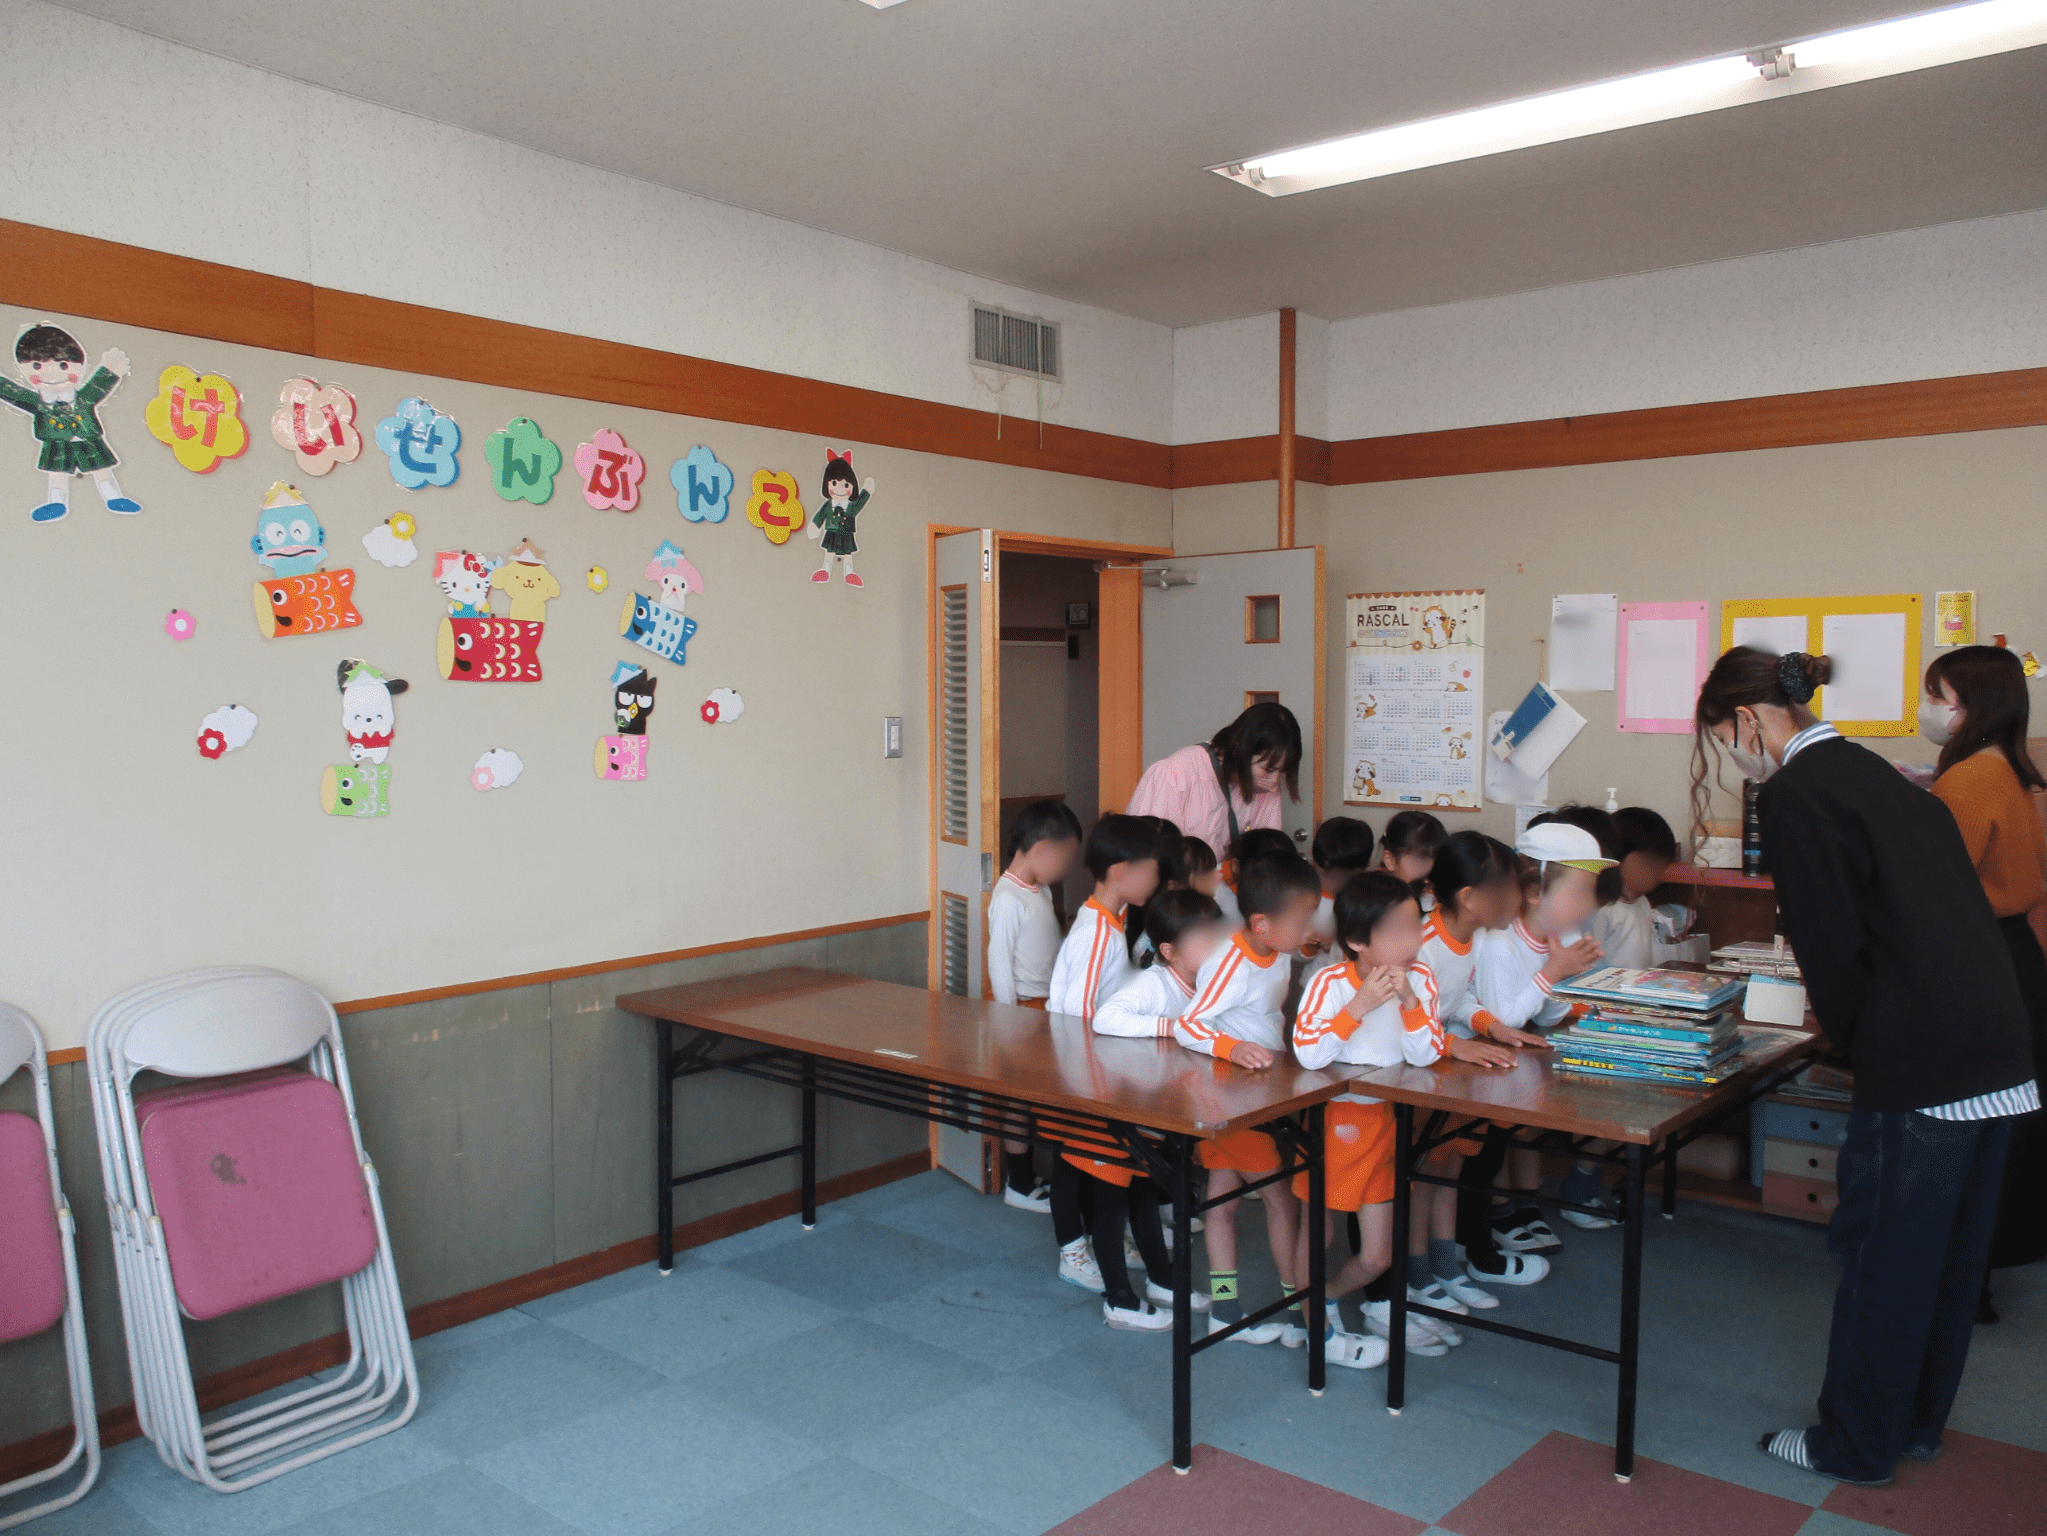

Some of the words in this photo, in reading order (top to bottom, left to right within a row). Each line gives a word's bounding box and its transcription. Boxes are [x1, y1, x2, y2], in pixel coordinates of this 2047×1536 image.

[170, 386, 791, 526] けいせんぶんこ
[1357, 613, 1409, 627] RASCAL
